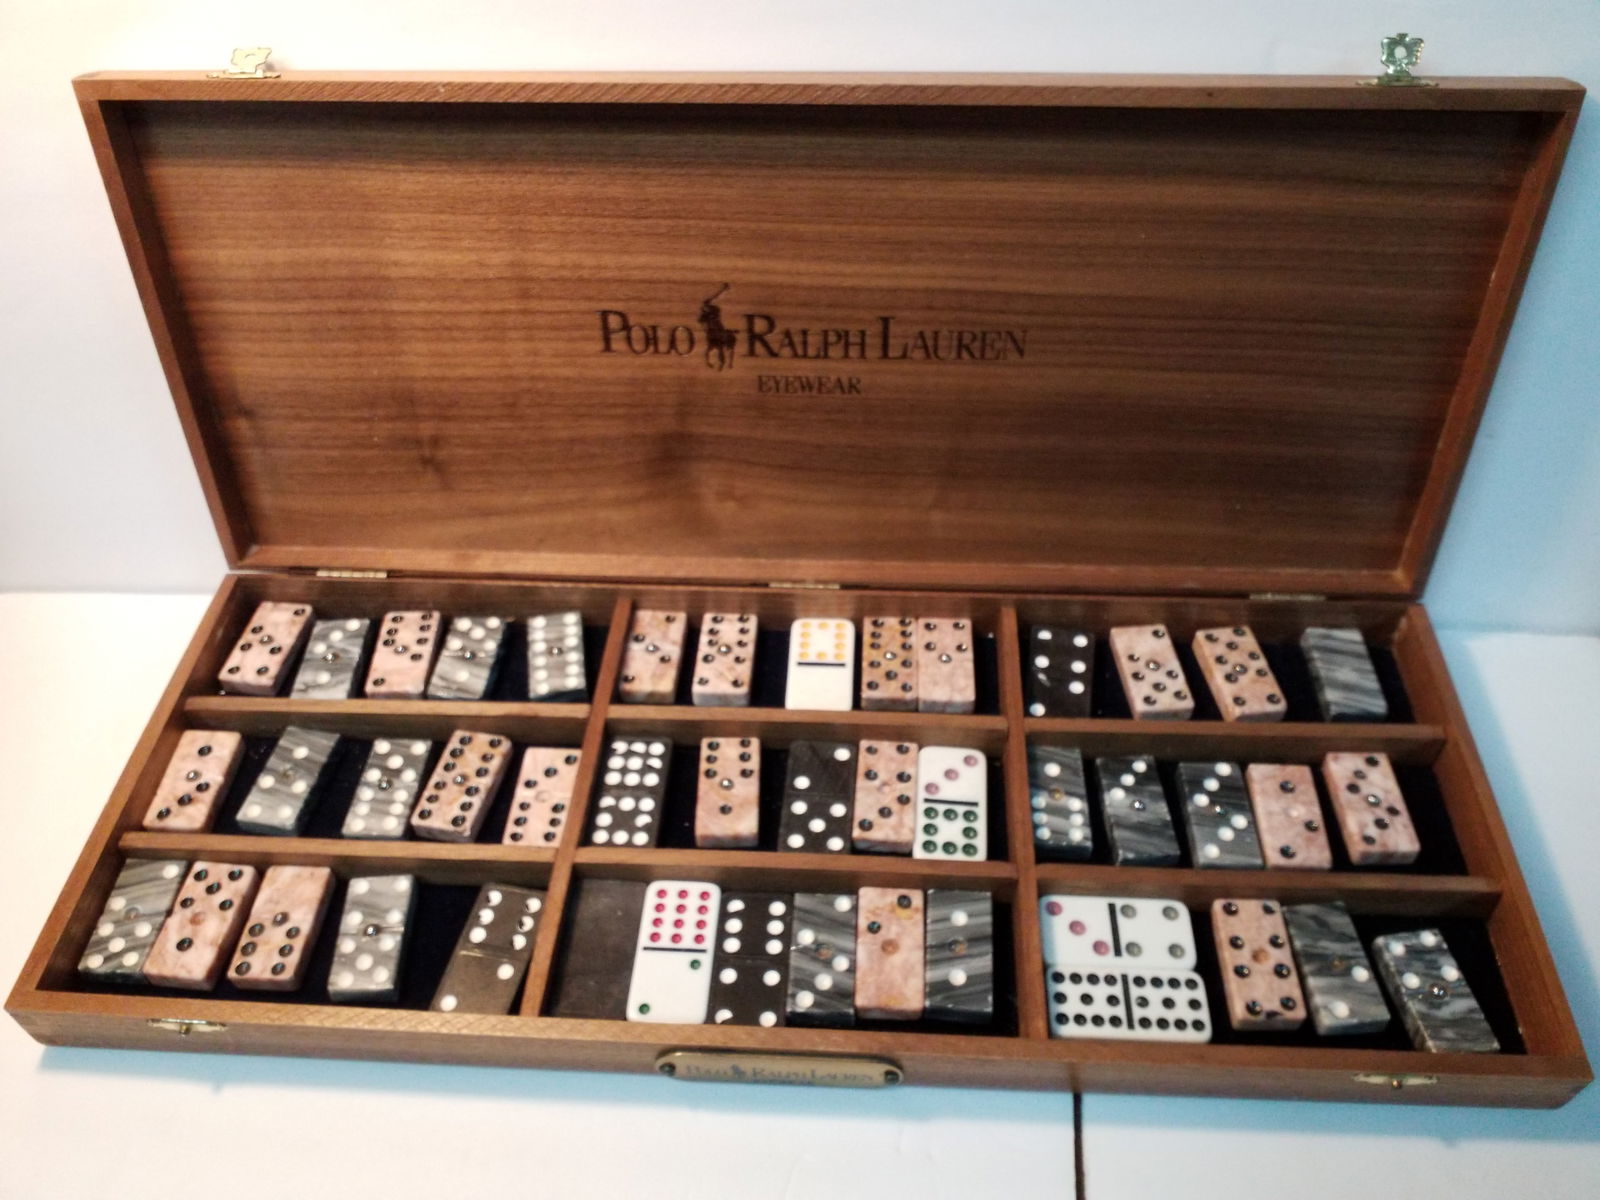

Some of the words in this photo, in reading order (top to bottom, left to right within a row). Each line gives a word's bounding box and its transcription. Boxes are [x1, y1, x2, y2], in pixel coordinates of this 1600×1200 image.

[597, 310, 696, 356] POLO
[743, 314, 868, 360] RALPH
[878, 316, 1028, 361] LAUREN
[757, 375, 862, 395] EYEWEAR
